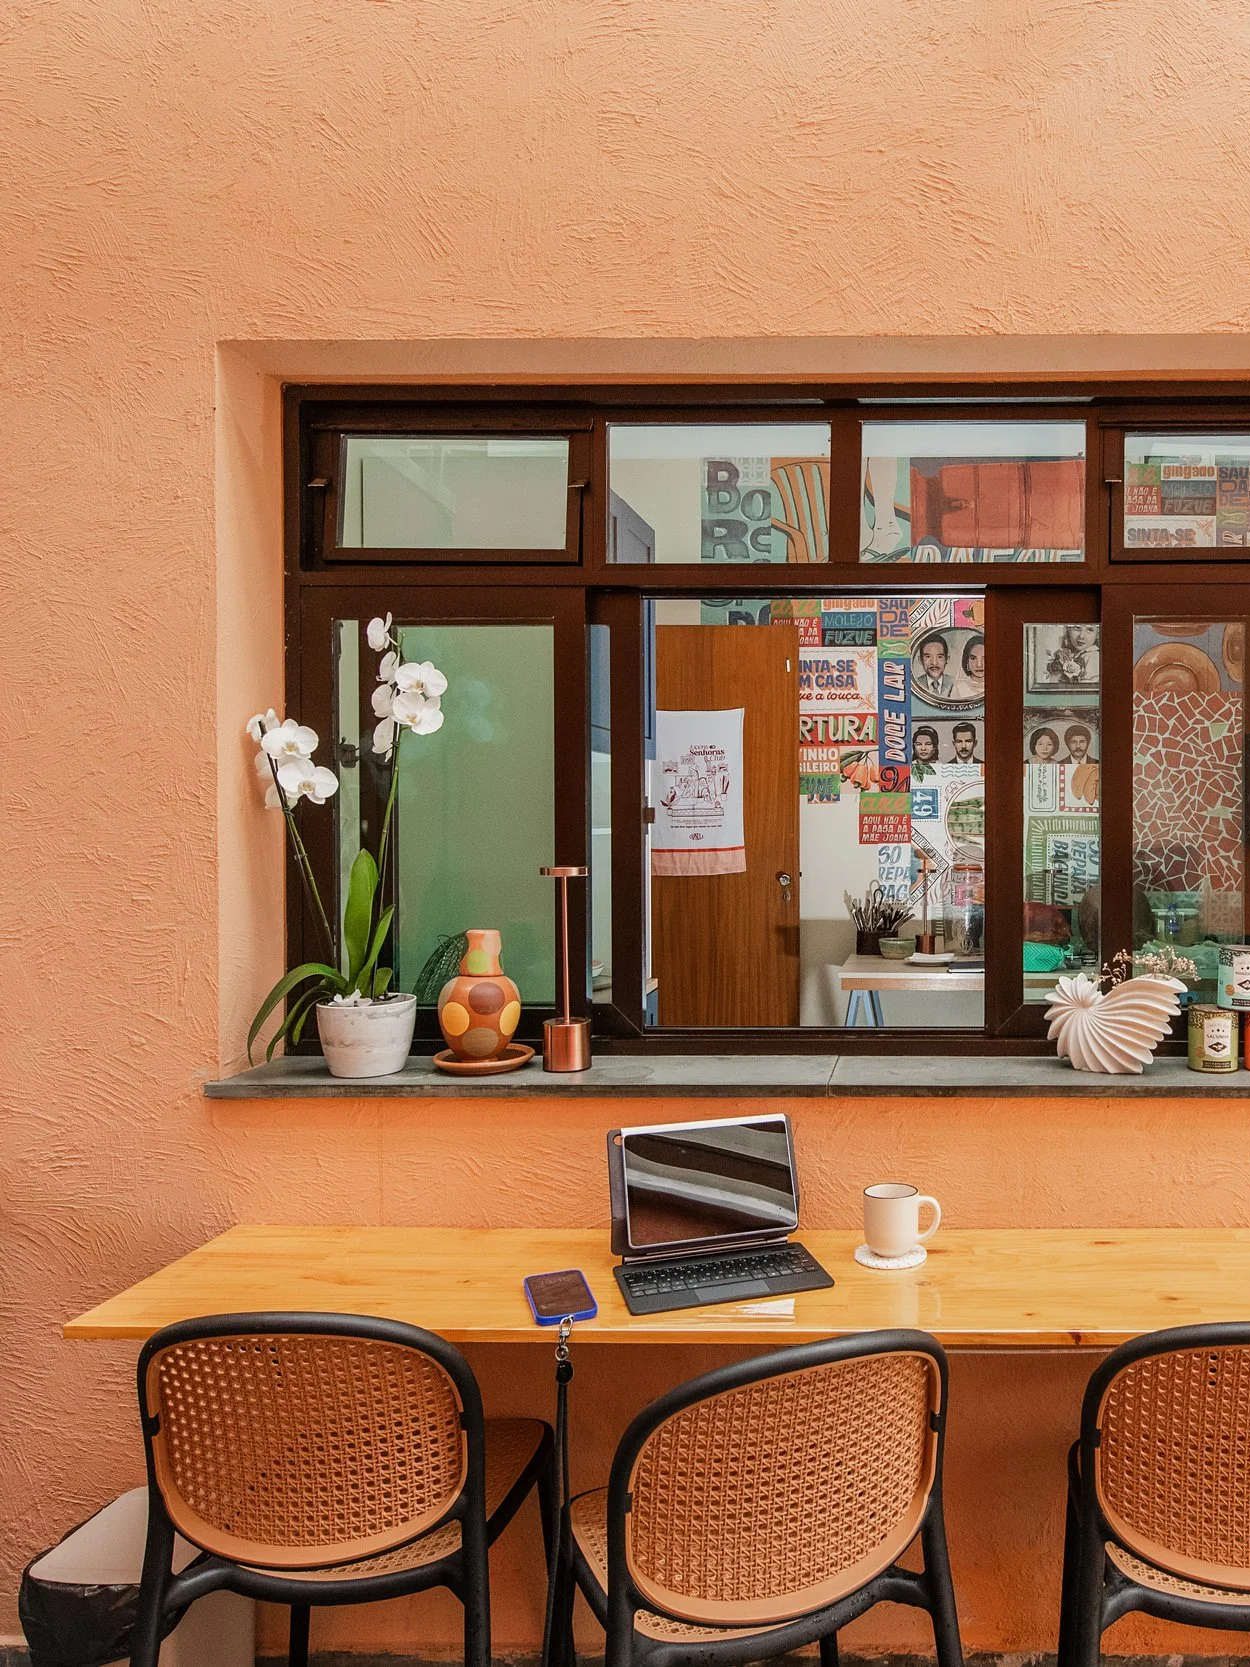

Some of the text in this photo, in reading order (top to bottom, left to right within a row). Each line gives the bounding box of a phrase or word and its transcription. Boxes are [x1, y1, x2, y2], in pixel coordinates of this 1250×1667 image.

[1124, 496, 1143, 504] ASA
[1127, 528, 1196, 545] SINTA-SE
[799, 636, 819, 645] OANA
[799, 659, 856, 674] INTA-SE
[815, 674, 857, 690] CASA
[883, 660, 906, 703] LAR
[799, 713, 877, 745] RTURA
[862, 814, 908, 825] AQUI NÃO É
[862, 825, 869, 833] A
[896, 825, 908, 833] DA
[861, 832, 909, 842] MÃE JOANA
